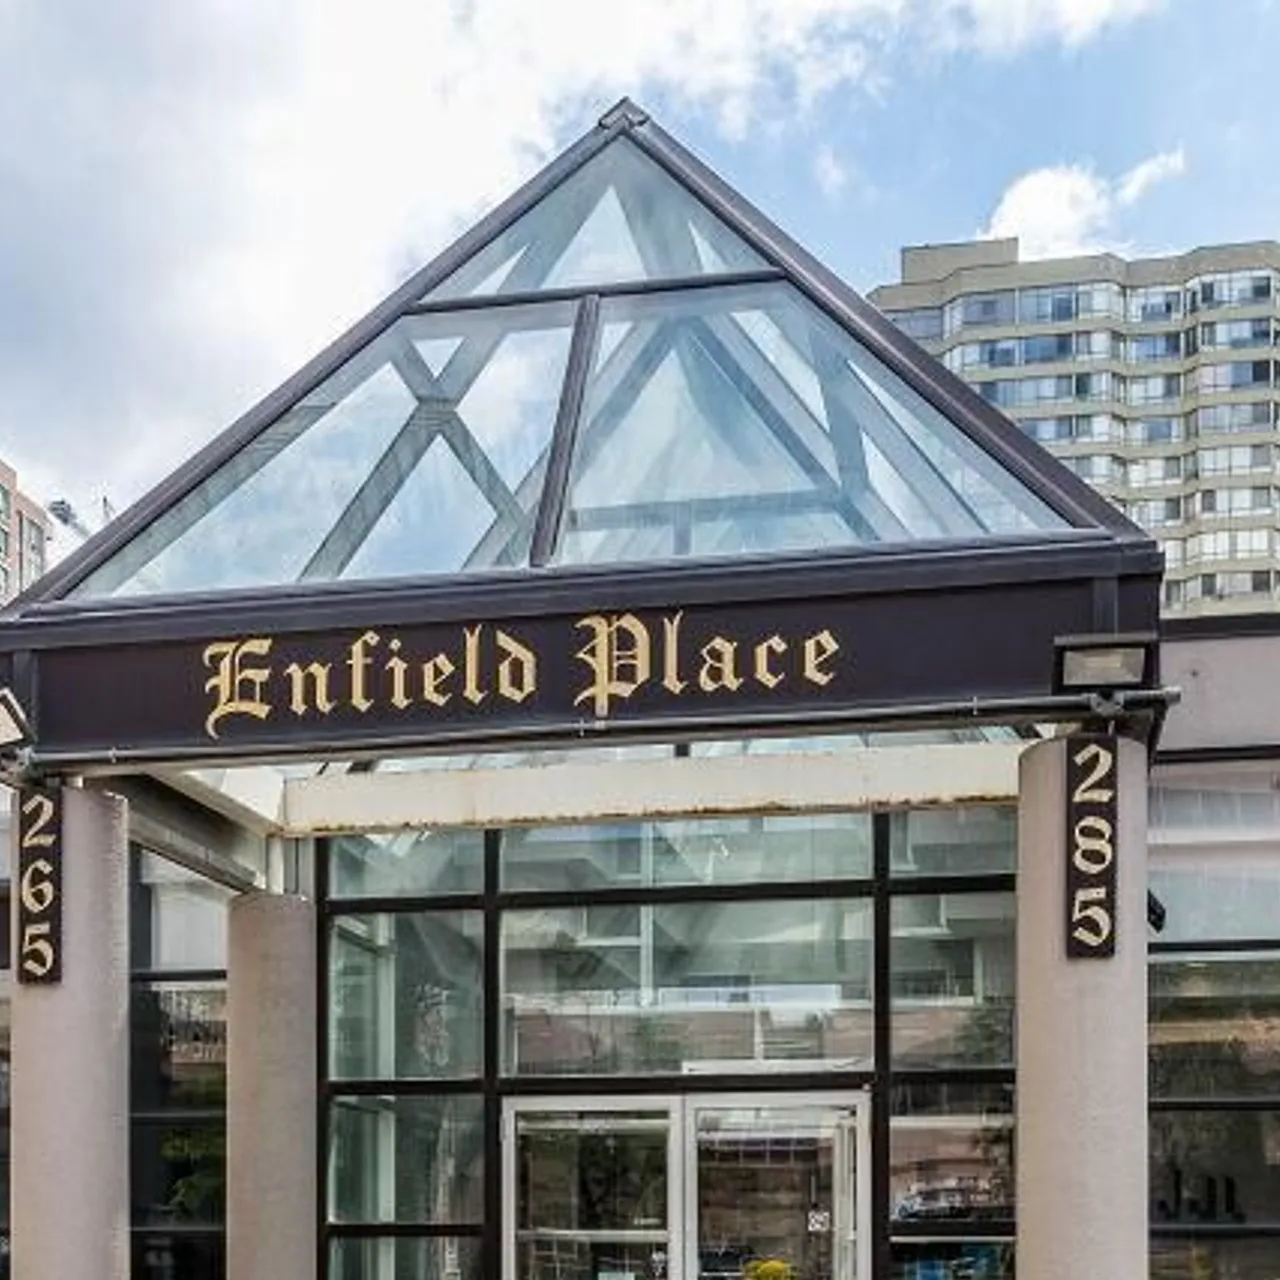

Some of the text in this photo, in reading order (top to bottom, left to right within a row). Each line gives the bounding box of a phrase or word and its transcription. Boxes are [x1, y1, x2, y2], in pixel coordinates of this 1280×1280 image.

[202, 609, 840, 740] Enfield Place
[22, 794, 56, 976] 265
[1073, 743, 1114, 946] 285
